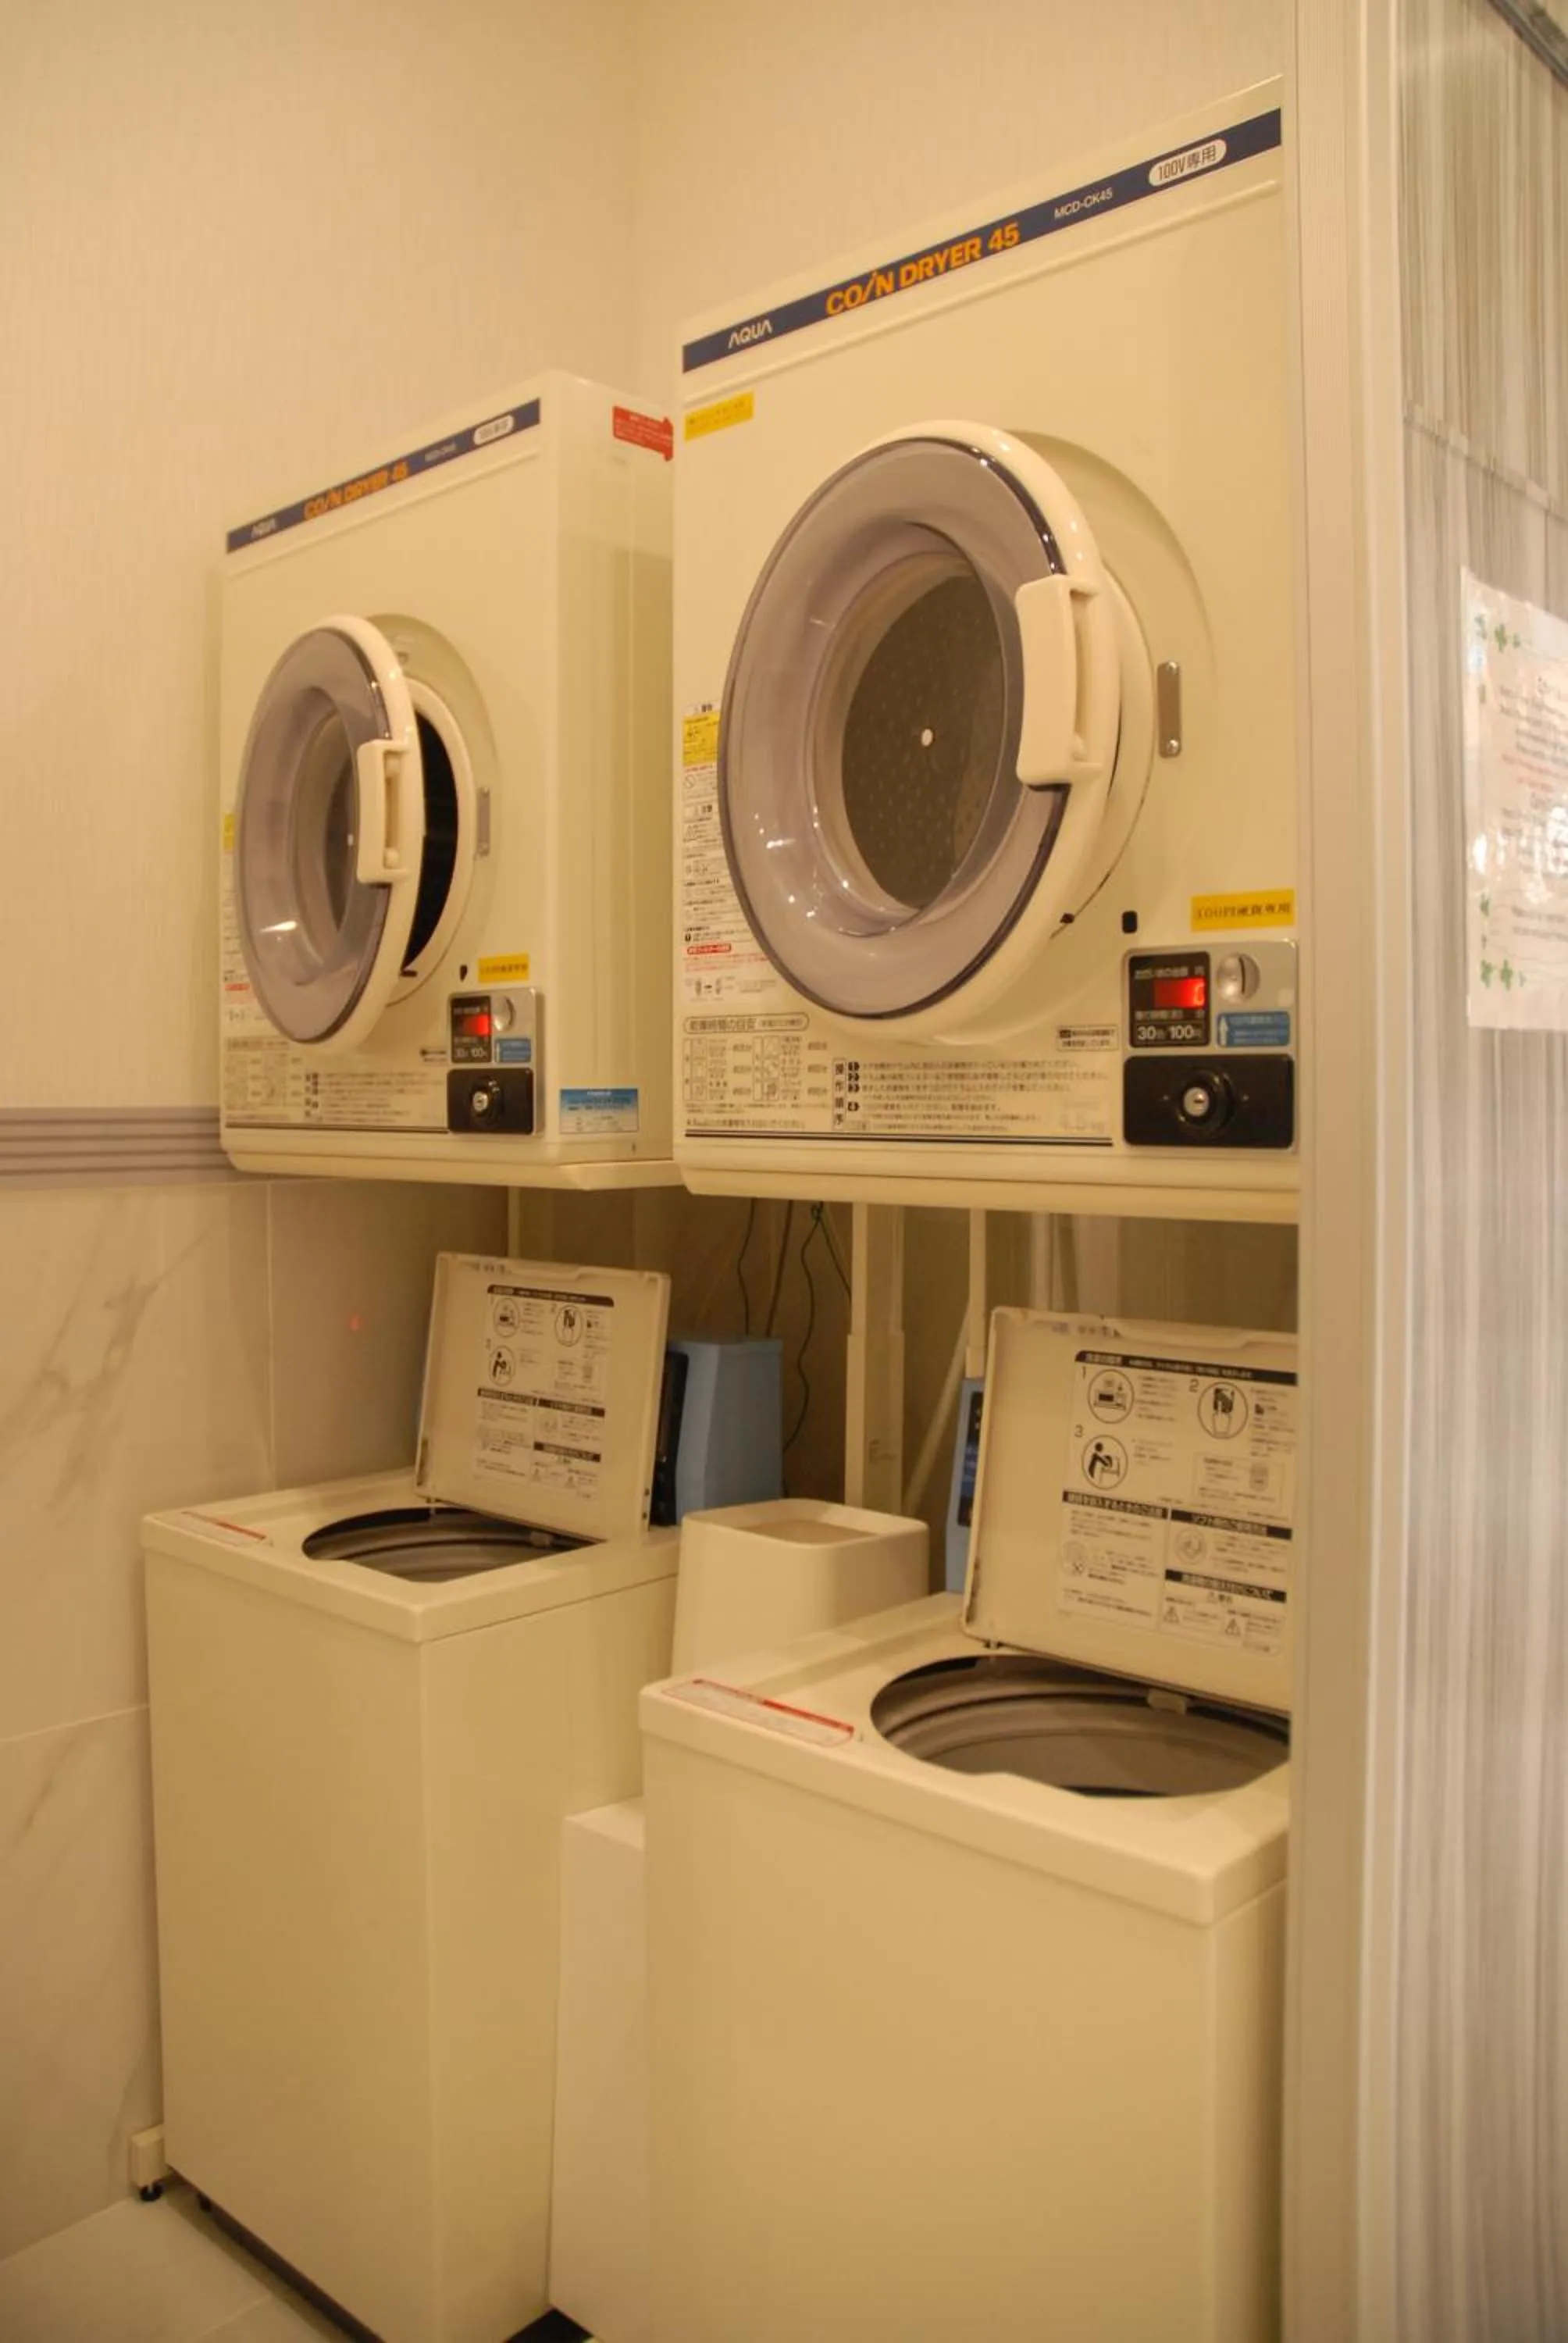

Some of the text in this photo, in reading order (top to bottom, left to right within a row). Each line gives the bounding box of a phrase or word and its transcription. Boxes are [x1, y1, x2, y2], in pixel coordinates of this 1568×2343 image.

[1054, 187, 1114, 219] MCD-CK45
[900, 237, 982, 288] DRYER
[988, 223, 1021, 251] 45
[727, 319, 773, 349] AQUA
